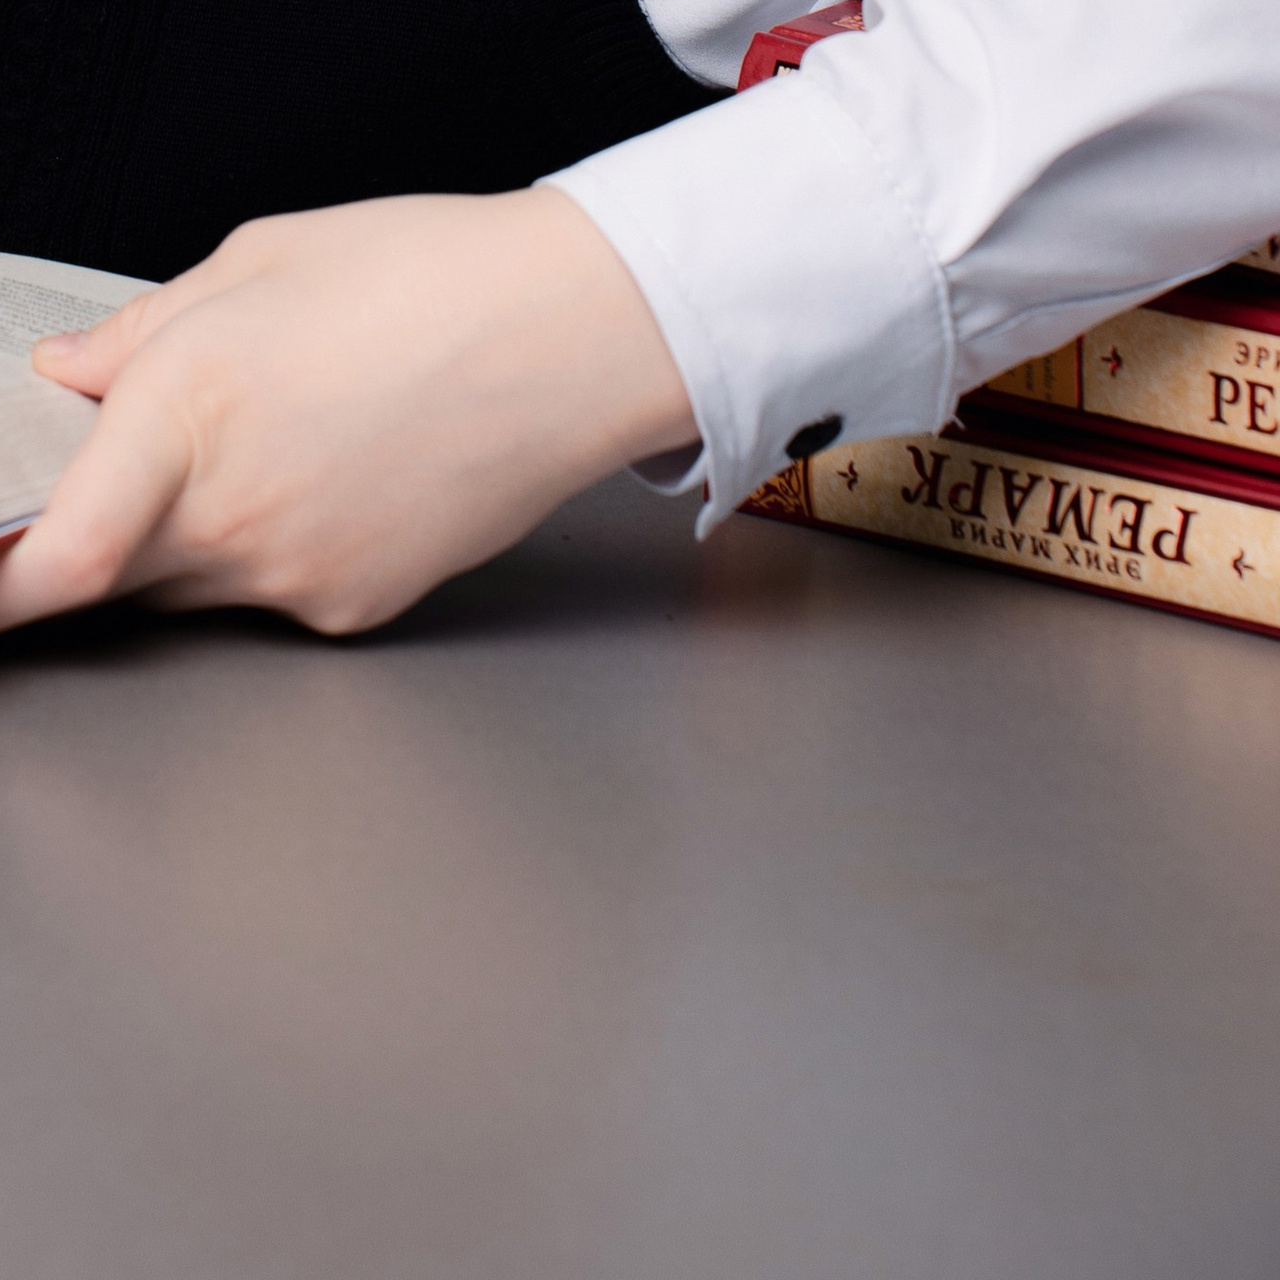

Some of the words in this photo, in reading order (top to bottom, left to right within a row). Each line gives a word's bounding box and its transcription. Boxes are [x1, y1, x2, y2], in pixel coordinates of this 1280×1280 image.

[901, 445, 1198, 566] РЕМАРК
[950, 518, 1052, 560] МАРИЯ
[1065, 543, 1143, 581] ЭРИХ
